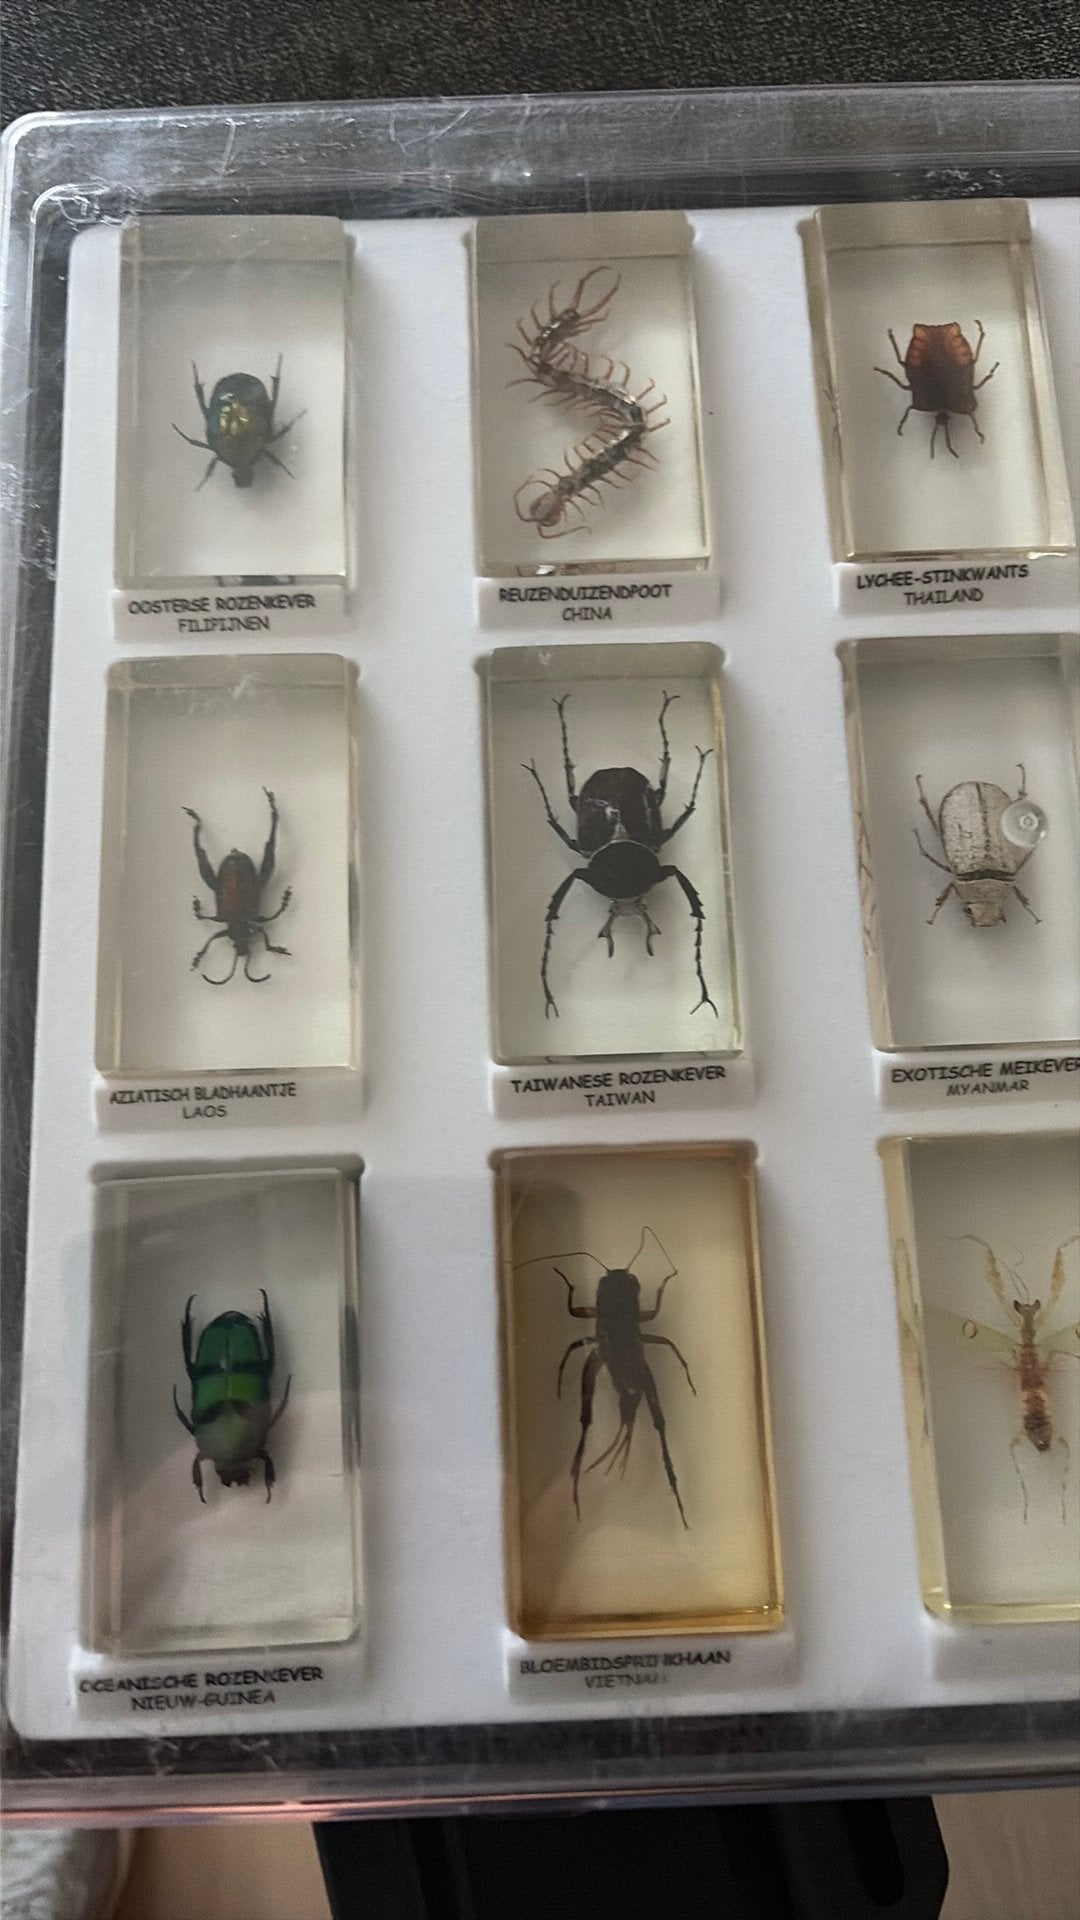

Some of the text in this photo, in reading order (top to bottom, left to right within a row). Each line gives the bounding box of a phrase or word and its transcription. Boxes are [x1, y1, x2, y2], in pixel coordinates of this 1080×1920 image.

[857, 564, 1029, 589] LYCHEE-STINKWANTS
[499, 584, 672, 602] REUZENDUIZENDPOOT
[904, 588, 984, 606] THAILAND
[128, 594, 315, 614] OOSTERSE ROZENKEVER
[562, 607, 612, 621] CHINA
[179, 616, 270, 633] FILIPIJNEN
[511, 1065, 726, 1093] TAIWANESE ROZENKEVER
[891, 1063, 993, 1083] EXOTISCHE
[109, 1082, 297, 1104] AZIATISCH BLADHAANTJE
[947, 1080, 1029, 1096] MYANMAR
[584, 1091, 655, 1107] TAIWAN
[182, 1105, 227, 1119] LAOS
[205, 1666, 323, 1686] ROZENKEVER
[585, 1673, 669, 1689] VIETNA
[131, 1690, 275, 1711] NIEUW-GUINEA
